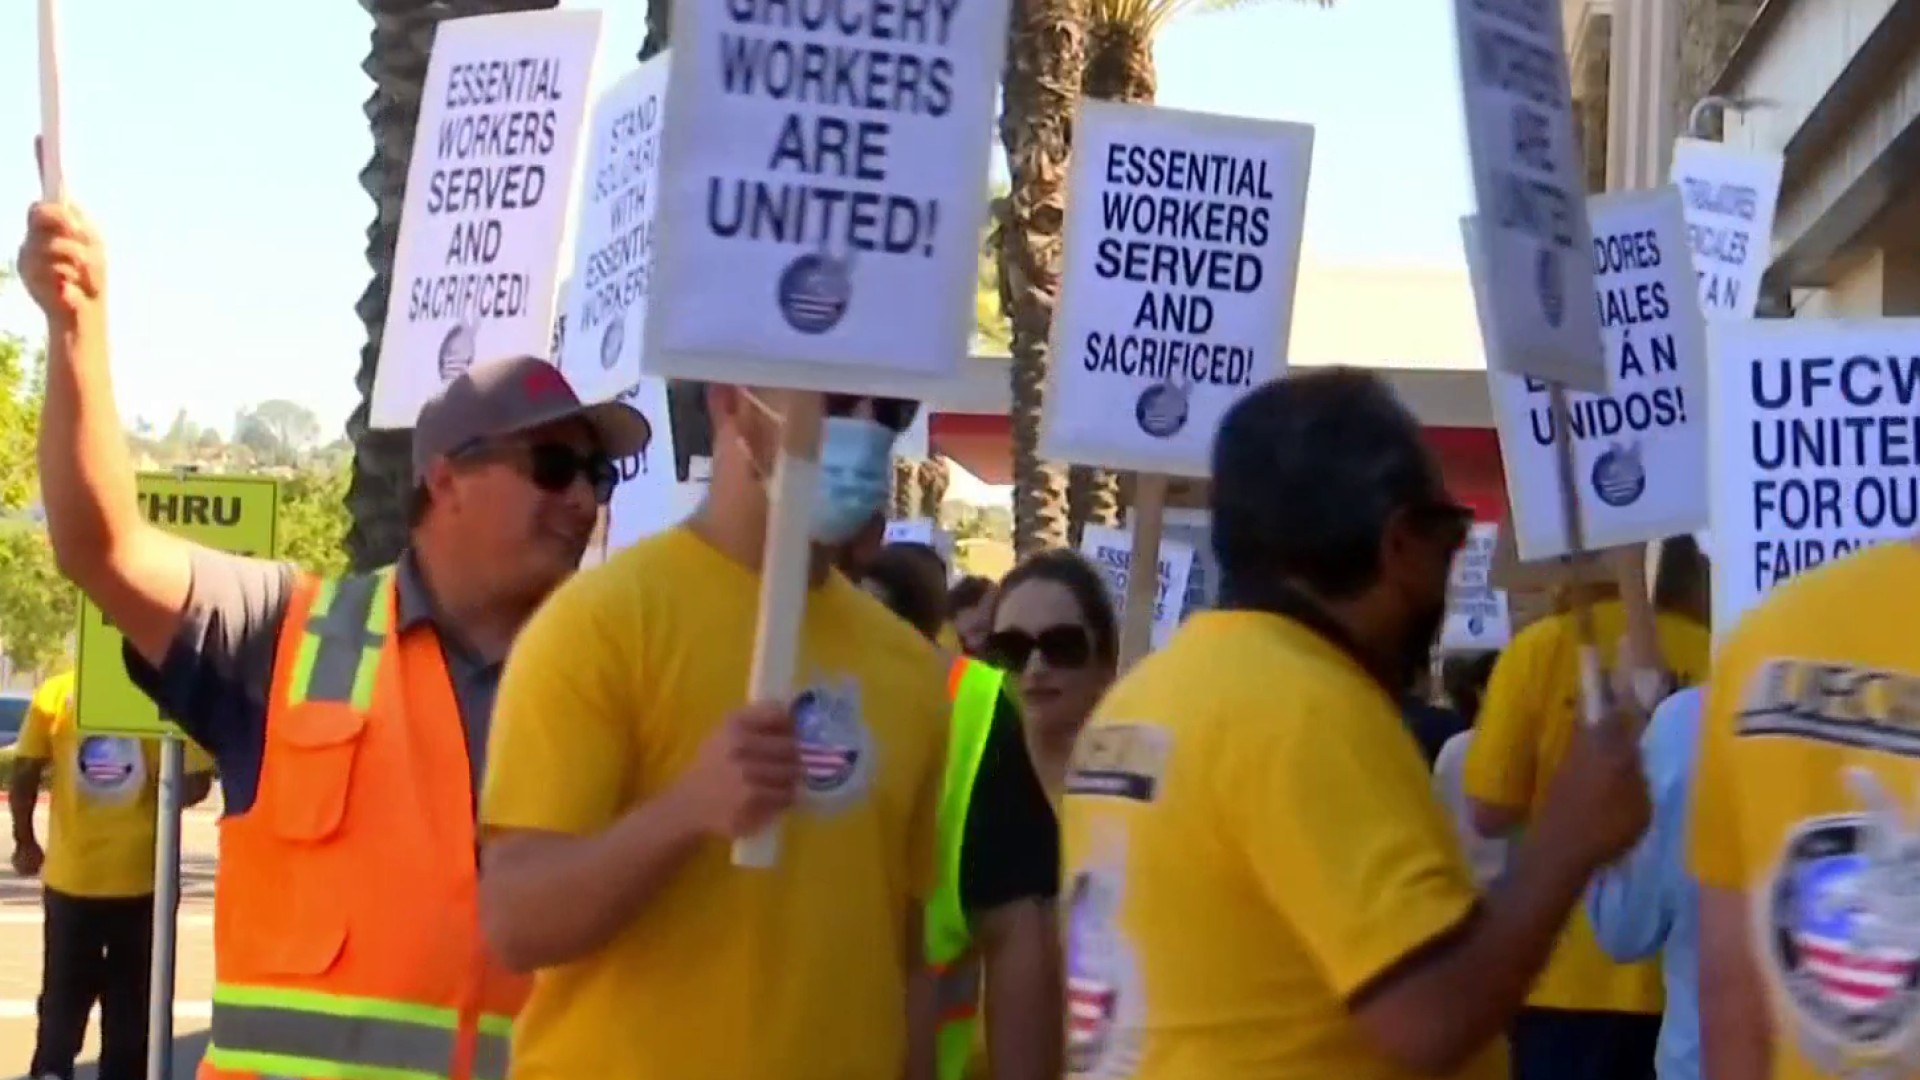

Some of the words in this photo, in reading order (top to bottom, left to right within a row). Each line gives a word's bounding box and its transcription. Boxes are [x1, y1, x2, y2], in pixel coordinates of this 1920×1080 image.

[446, 58, 563, 106] ESSENTIAL
[720, 32, 953, 117] WORKERS
[437, 110, 555, 159] WORKERS
[768, 113, 889, 181] ARE
[427, 165, 545, 214] SERVED
[1106, 143, 1273, 199] ESSENTIAL
[611, 180, 646, 234] WITH
[708, 176, 938, 257] UNITED!
[1102, 191, 1270, 246] WORKERS
[445, 221, 501, 266] AND
[1095, 238, 1263, 293] SERVED
[409, 273, 529, 323] SACRIFICED!
[1134, 291, 1213, 334] AND
[1084, 332, 1254, 387] SACRIFICED!
[1530, 386, 1687, 445] UNIDOS!
[1752, 415, 1920, 470] UNITE
[138, 492, 242, 526] HRU
[1753, 477, 1842, 531] FOR
